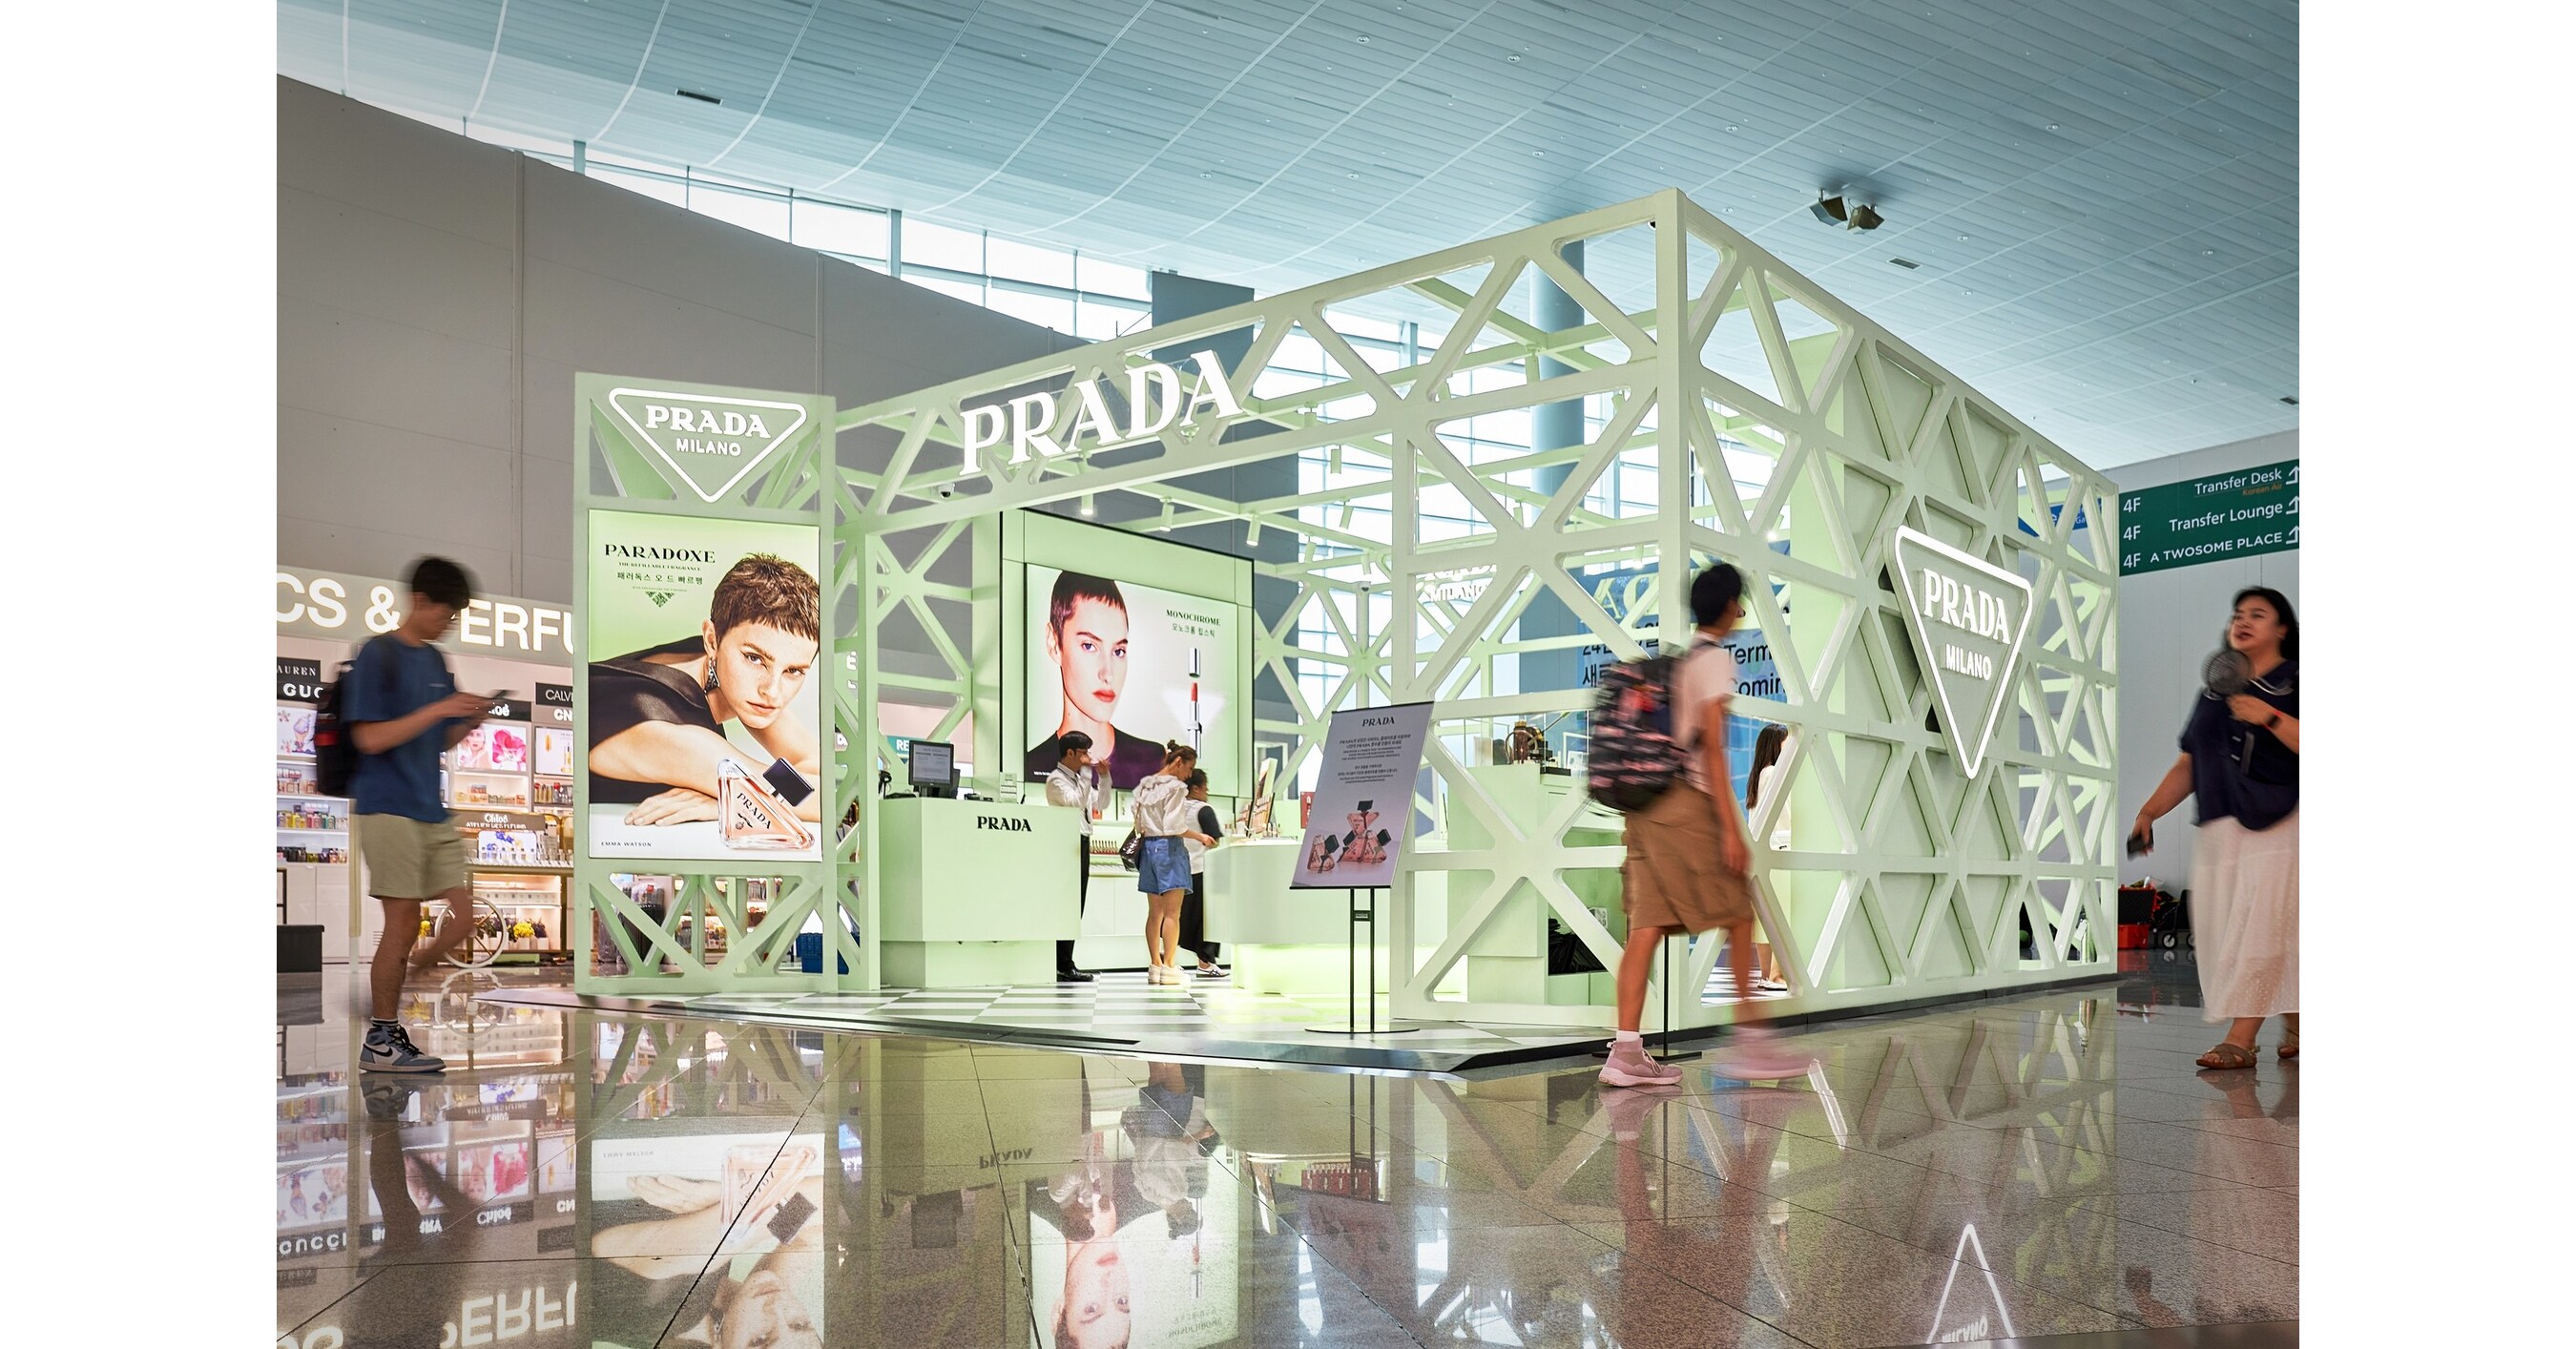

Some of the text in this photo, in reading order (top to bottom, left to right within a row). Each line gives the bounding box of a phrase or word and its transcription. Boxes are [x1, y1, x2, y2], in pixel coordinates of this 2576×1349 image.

[645, 404, 771, 439] PRADA
[959, 349, 1244, 477] PRADA
[675, 437, 741, 457] MILANO
[2123, 467, 2282, 513] 4F Transfer Desk
[2242, 486, 2270, 496] Korean
[2123, 503, 2283, 541] 4F Transfer Lounge
[605, 543, 716, 564] PARADOXE
[2123, 532, 2282, 569] 4F A TWOSOME PLACE
[654, 573, 663, 583] 오
[667, 574, 675, 583] 드
[364, 585, 401, 634] &
[451, 598, 574, 655] ERF
[1166, 609, 1221, 627] MONOCHROME
[1922, 568, 2011, 645] PRADA
[1944, 643, 1992, 681] MILANO
[1361, 716, 1396, 728] PRADA
[737, 792, 773, 830] PRADA
[976, 815, 1032, 833] PRADA
